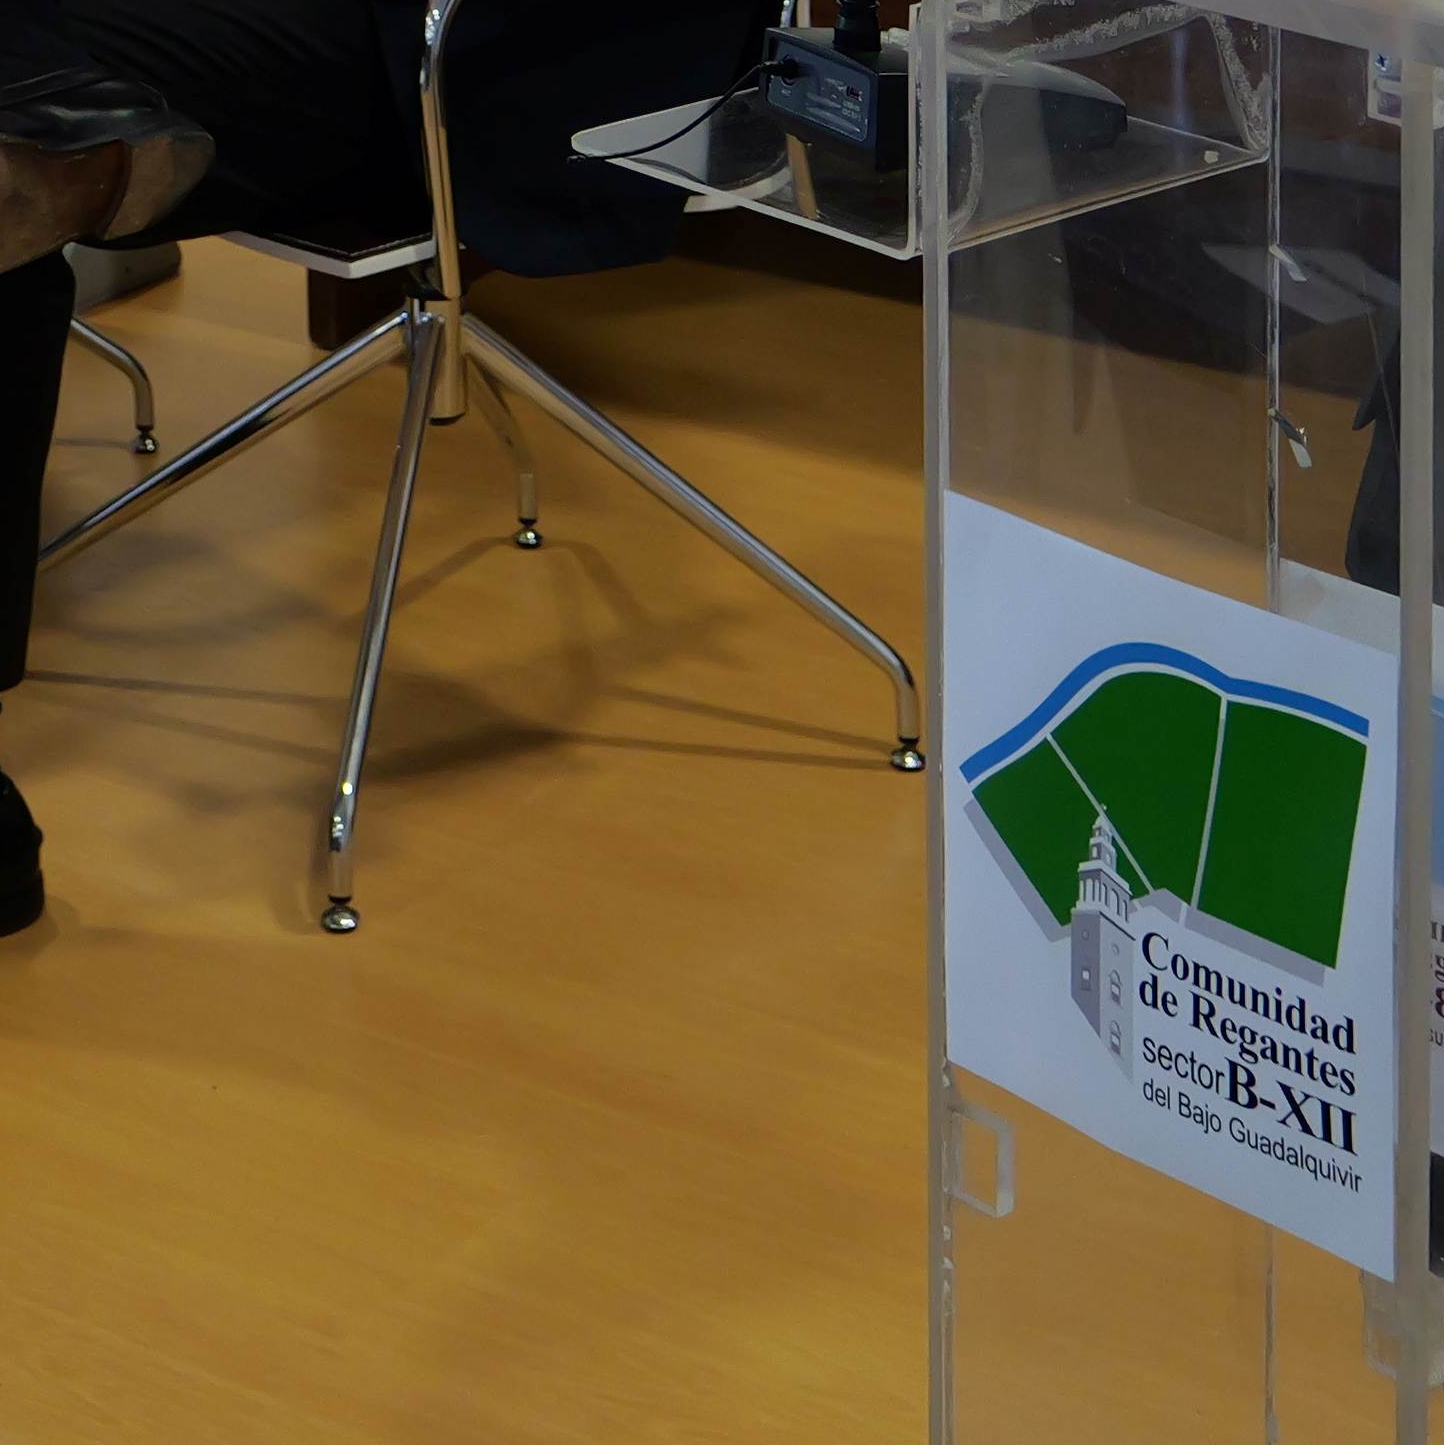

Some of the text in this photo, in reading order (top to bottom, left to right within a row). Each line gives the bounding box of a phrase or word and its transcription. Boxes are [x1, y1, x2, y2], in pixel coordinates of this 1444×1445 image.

[1139, 973, 1356, 1096] de Regantes
[1141, 932, 1357, 1055] Comunidad
[1142, 1078, 1363, 1193] del Bajo Guadalquivir
